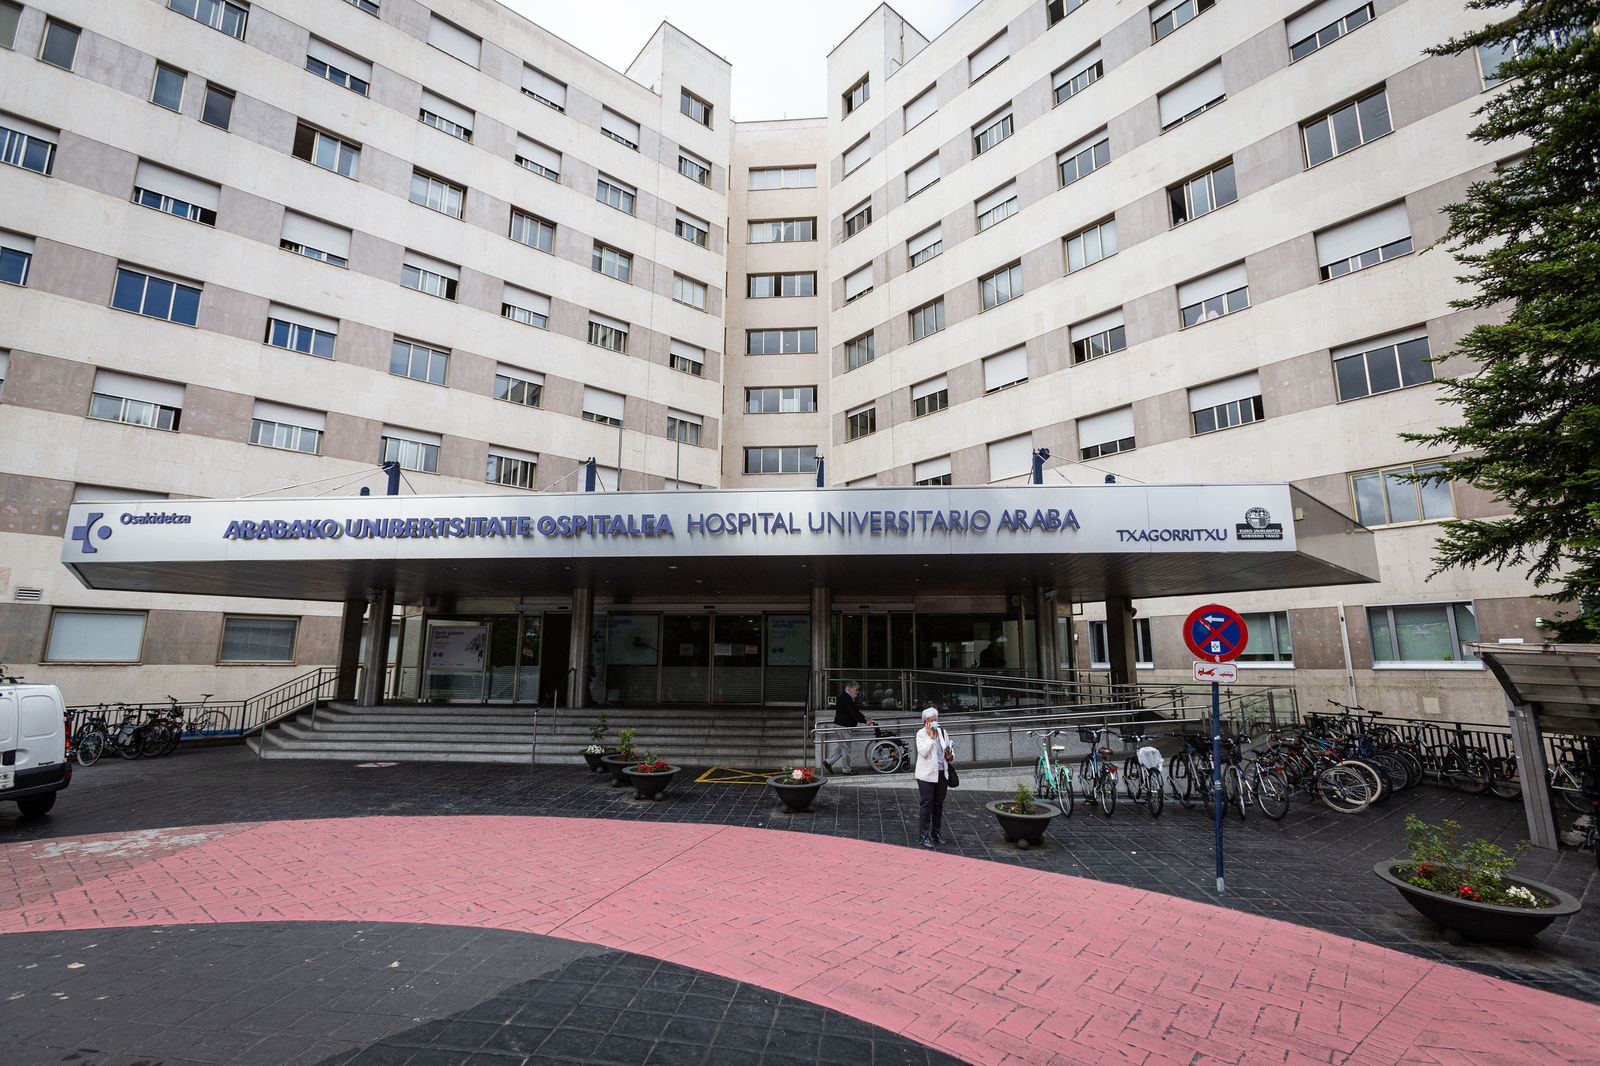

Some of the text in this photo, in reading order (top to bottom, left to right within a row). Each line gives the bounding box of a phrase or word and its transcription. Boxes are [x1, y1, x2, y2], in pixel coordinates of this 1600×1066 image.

[120, 512, 191, 525] Osakidetza
[224, 508, 1081, 541] ARABAKO UNIBERTSITATE OSPITALEA HOSPITAL UNIVERSITARIO ARABA
[1116, 528, 1229, 543] TXAGORRITXU
